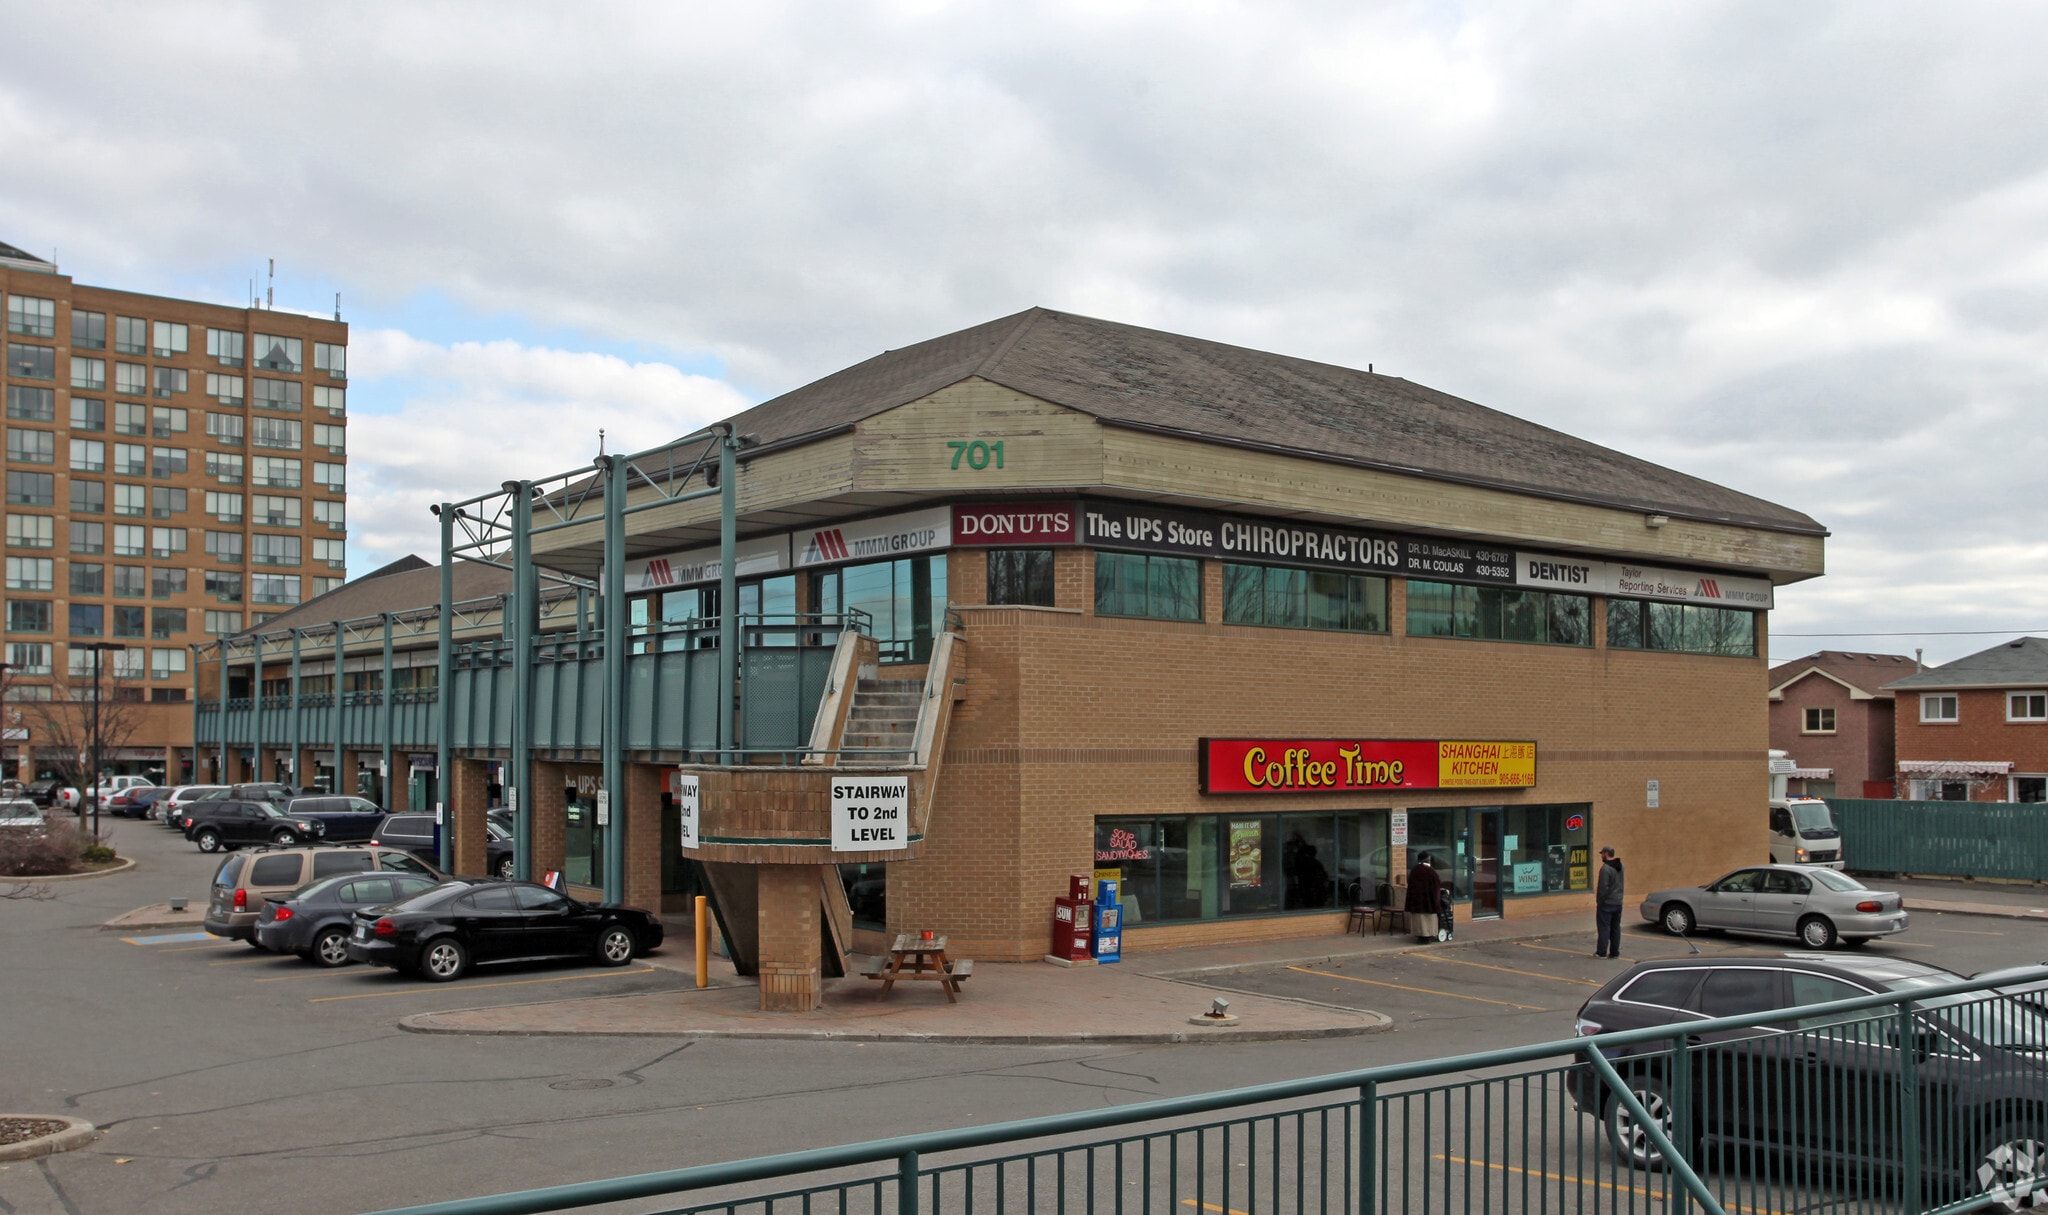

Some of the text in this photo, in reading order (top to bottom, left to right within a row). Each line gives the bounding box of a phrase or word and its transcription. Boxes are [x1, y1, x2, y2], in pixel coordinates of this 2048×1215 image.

[947, 440, 1004, 470] 701
[961, 512, 1070, 535] DONUTS
[1086, 512, 1213, 547] The UPS Store
[854, 530, 936, 556] MMM GROUP
[1221, 522, 1399, 566] CHIROPRACTORS
[1408, 543, 1472, 560] DR. D. MacASKILL
[1475, 551, 1509, 563] 430-6787
[1408, 558, 1464, 573] DR. M. COULAS
[1475, 565, 1510, 578] 430-5352
[1529, 561, 1590, 584] DENTIST
[1622, 566, 1642, 579] Taylor
[1619, 579, 1687, 596] Reporting Services
[1725, 590, 1768, 602] MMM GROUP
[1441, 744, 1501, 759] SHANGHAI
[1243, 743, 1404, 787] Coffee Time
[1452, 761, 1499, 775] KITCHEN
[578, 775, 596, 795] UPS
[1499, 773, 1534, 785] 905-666-1166
[833, 784, 906, 799] STAIRWAY
[847, 806, 898, 820] TO 2nd
[1566, 817, 1584, 828] OPEN
[851, 828, 895, 842] LEVEL
[1112, 828, 1135, 841] SOUP
[1110, 837, 1138, 850] SALAD
[1096, 849, 1149, 861] SANDWICHES
[1570, 849, 1587, 864] ATM
[1518, 875, 1538, 884] WIND
[1057, 907, 1072, 921] SUN
